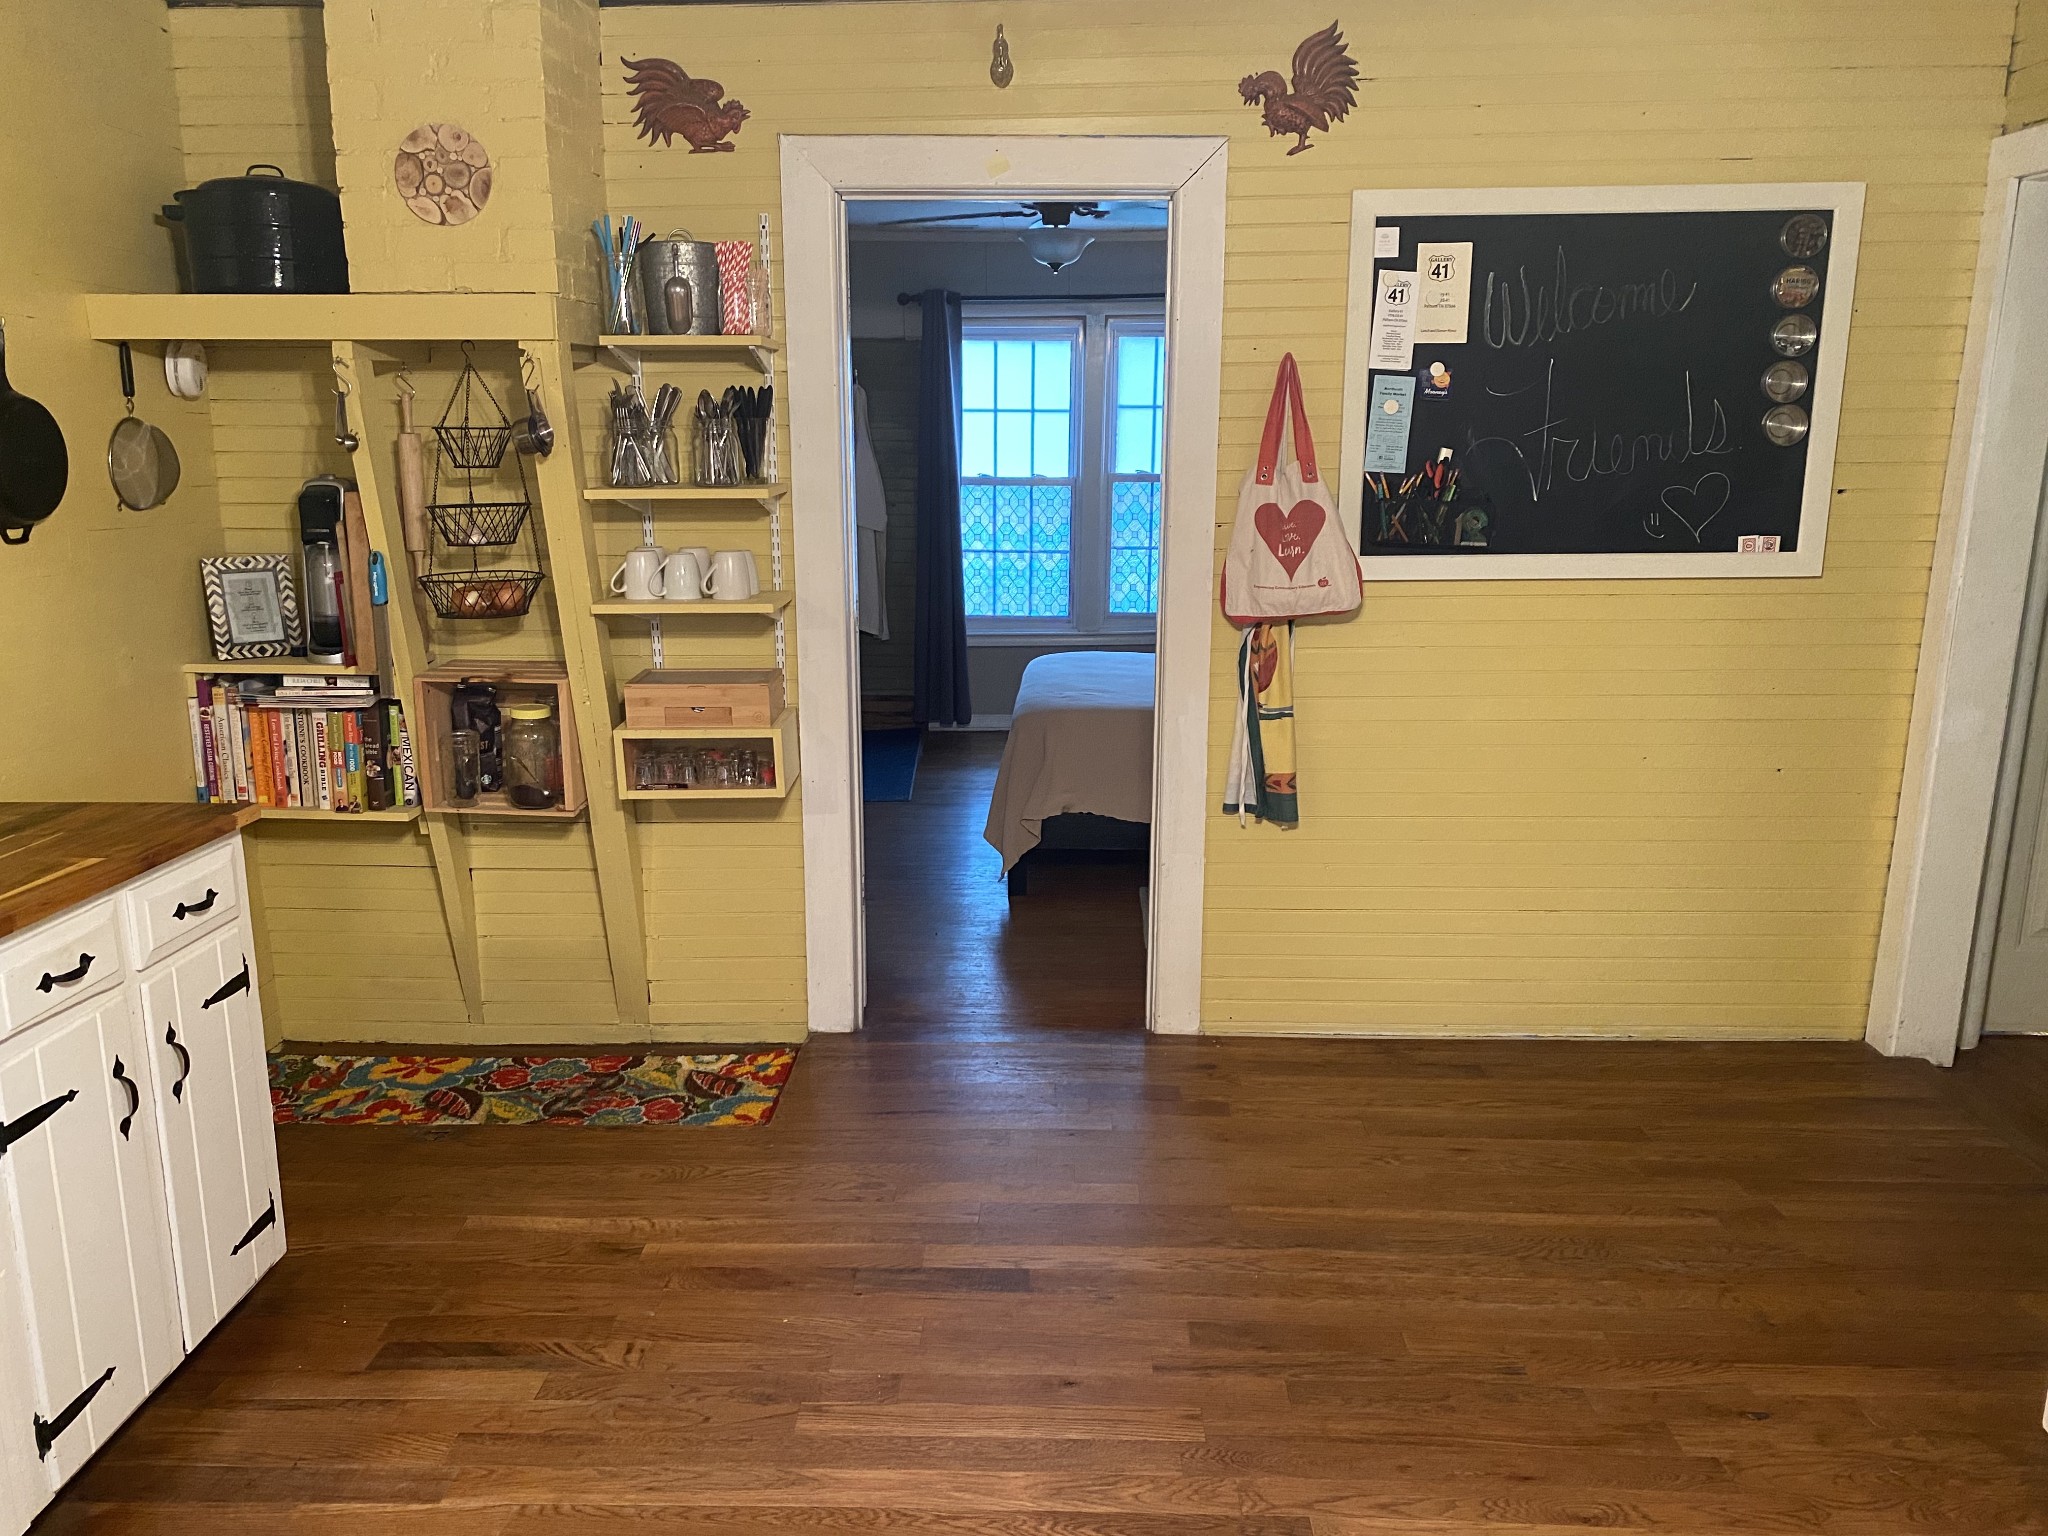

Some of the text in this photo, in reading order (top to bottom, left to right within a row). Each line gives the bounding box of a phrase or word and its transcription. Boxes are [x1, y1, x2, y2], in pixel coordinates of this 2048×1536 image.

[1388, 288, 1404, 302] 41
[1432, 264, 1449, 278] 41
[1484, 245, 1697, 348] Welcome
[218, 716, 229, 779] American Classics
[297, 710, 309, 785] NTOINE'S COOKBOOK
[315, 722, 326, 768] GRILLING
[402, 737, 414, 790] MEXICAN
[275, 762, 283, 790] Cookbook
